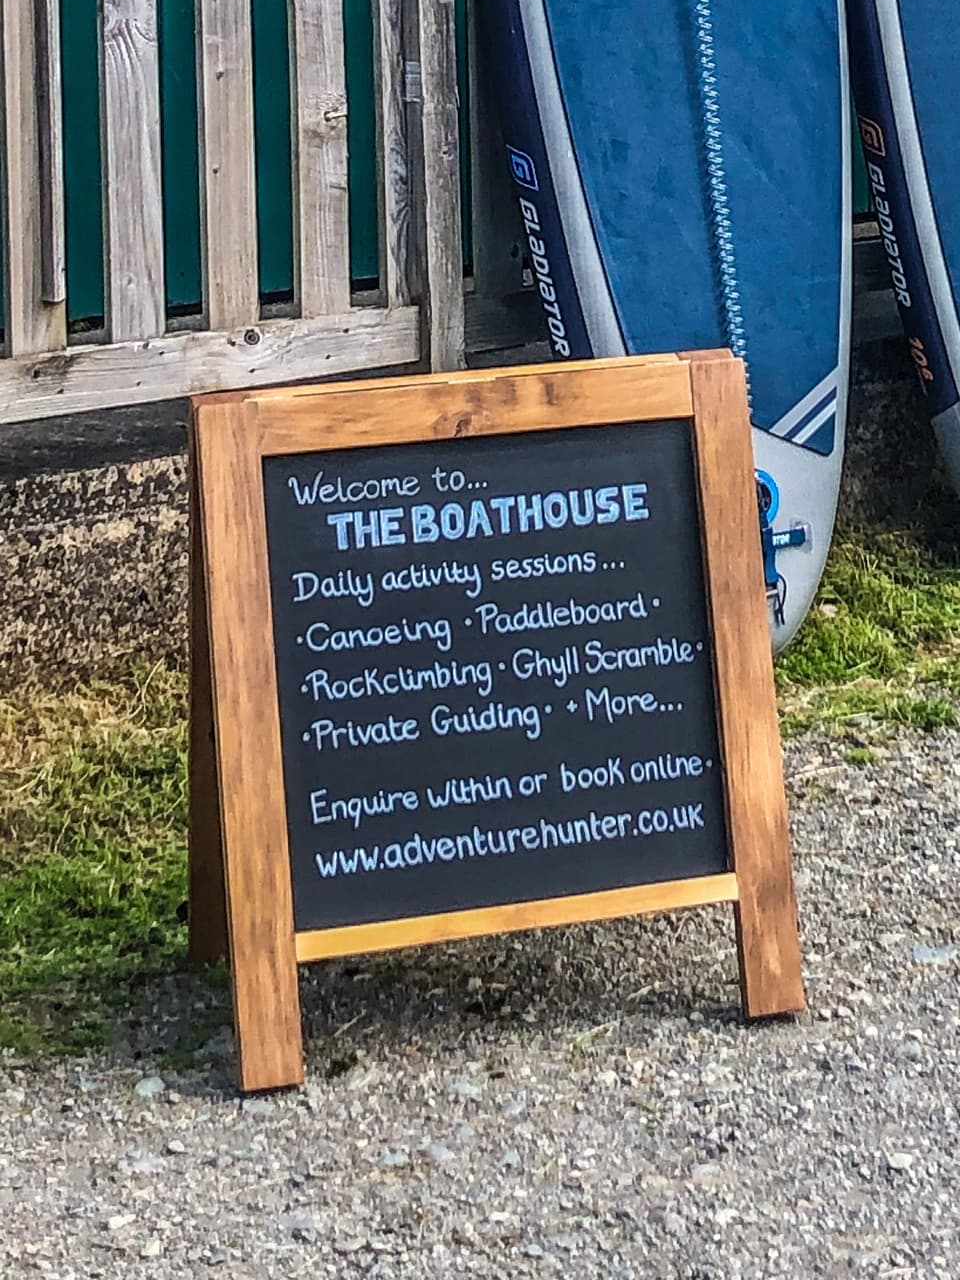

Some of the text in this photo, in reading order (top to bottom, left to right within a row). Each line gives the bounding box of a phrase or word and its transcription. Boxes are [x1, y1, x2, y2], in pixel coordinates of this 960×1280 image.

[288, 467, 488, 505] Welcome to...
[327, 483, 650, 550] THE BOATHOUSE
[292, 569, 374, 607] Daily
[382, 561, 482, 598] activity
[306, 593, 648, 652] Canoeing Paddleboard
[513, 646, 580, 687] Ghyll
[585, 638, 694, 674] Scramble
[311, 715, 420, 751] Private
[431, 702, 541, 740] Guiding
[310, 788, 419, 829] Enquire
[426, 775, 513, 808] within
[519, 772, 547, 796] or
[315, 803, 705, 878] www.adventurehunter.co.uk
